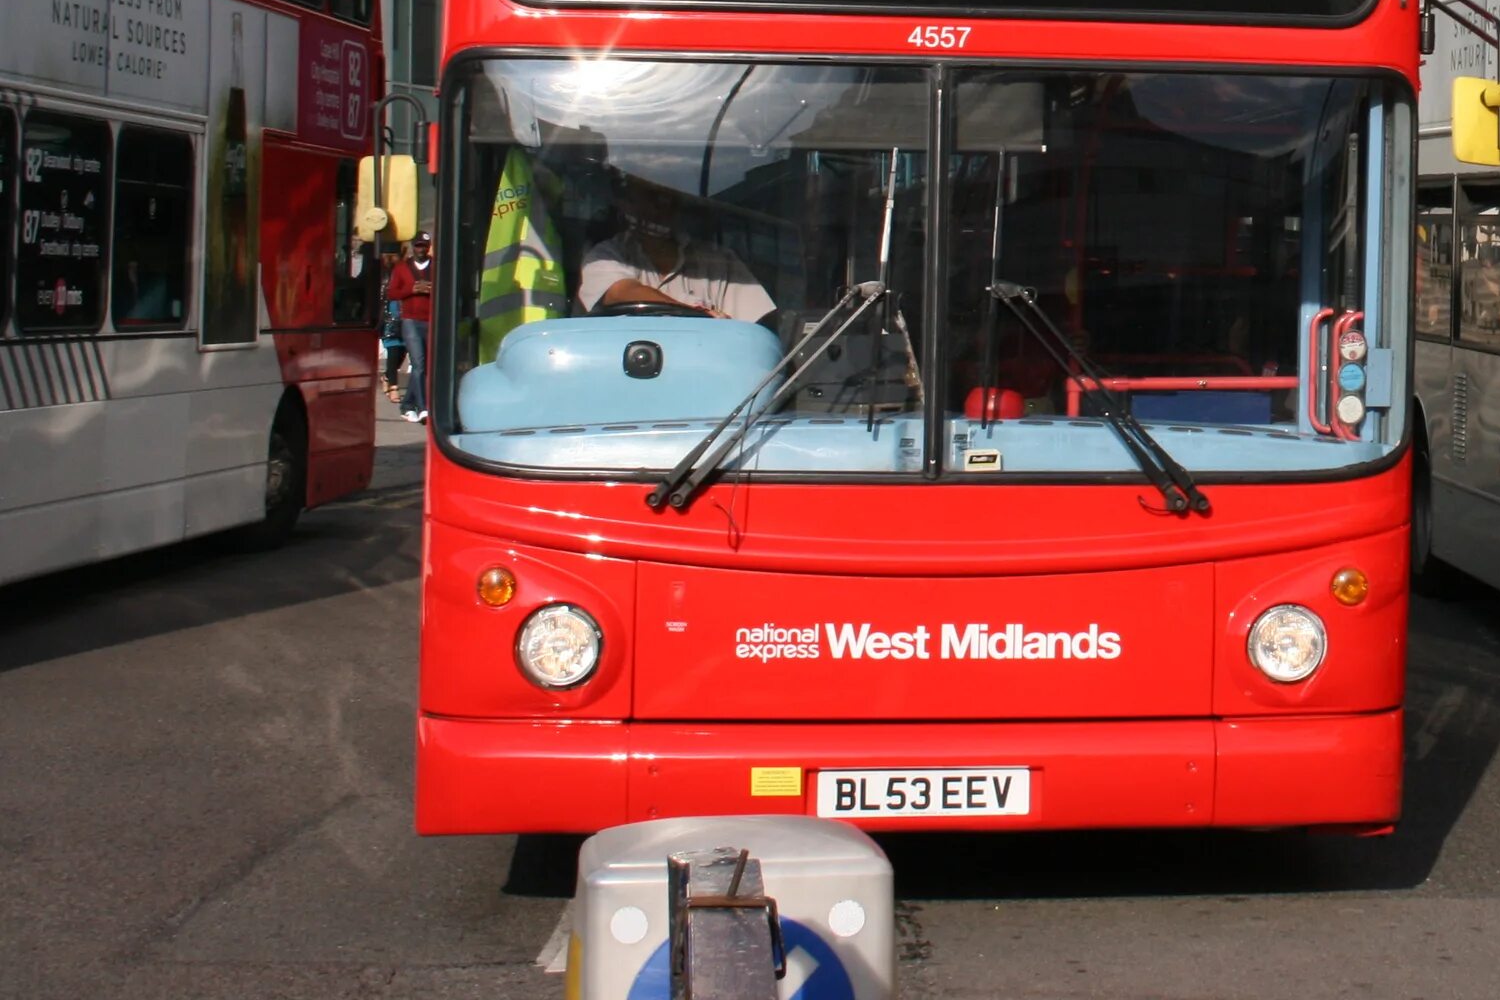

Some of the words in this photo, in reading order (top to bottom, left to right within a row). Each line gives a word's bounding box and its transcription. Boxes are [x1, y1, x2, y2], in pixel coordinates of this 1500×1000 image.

[127, 18, 186, 54] SOURCES
[907, 25, 972, 48] 4557
[72, 41, 110, 68] LOWE
[348, 51, 361, 87] 82
[347, 92, 361, 128] 87
[25, 148, 42, 182] 82
[24, 210, 40, 243] 87
[735, 642, 820, 664] express
[736, 622, 819, 643] national
[825, 623, 930, 659] West
[940, 622, 1122, 659] Midlands
[835, 776, 931, 811] BL53
[941, 775, 1013, 810] EEV
